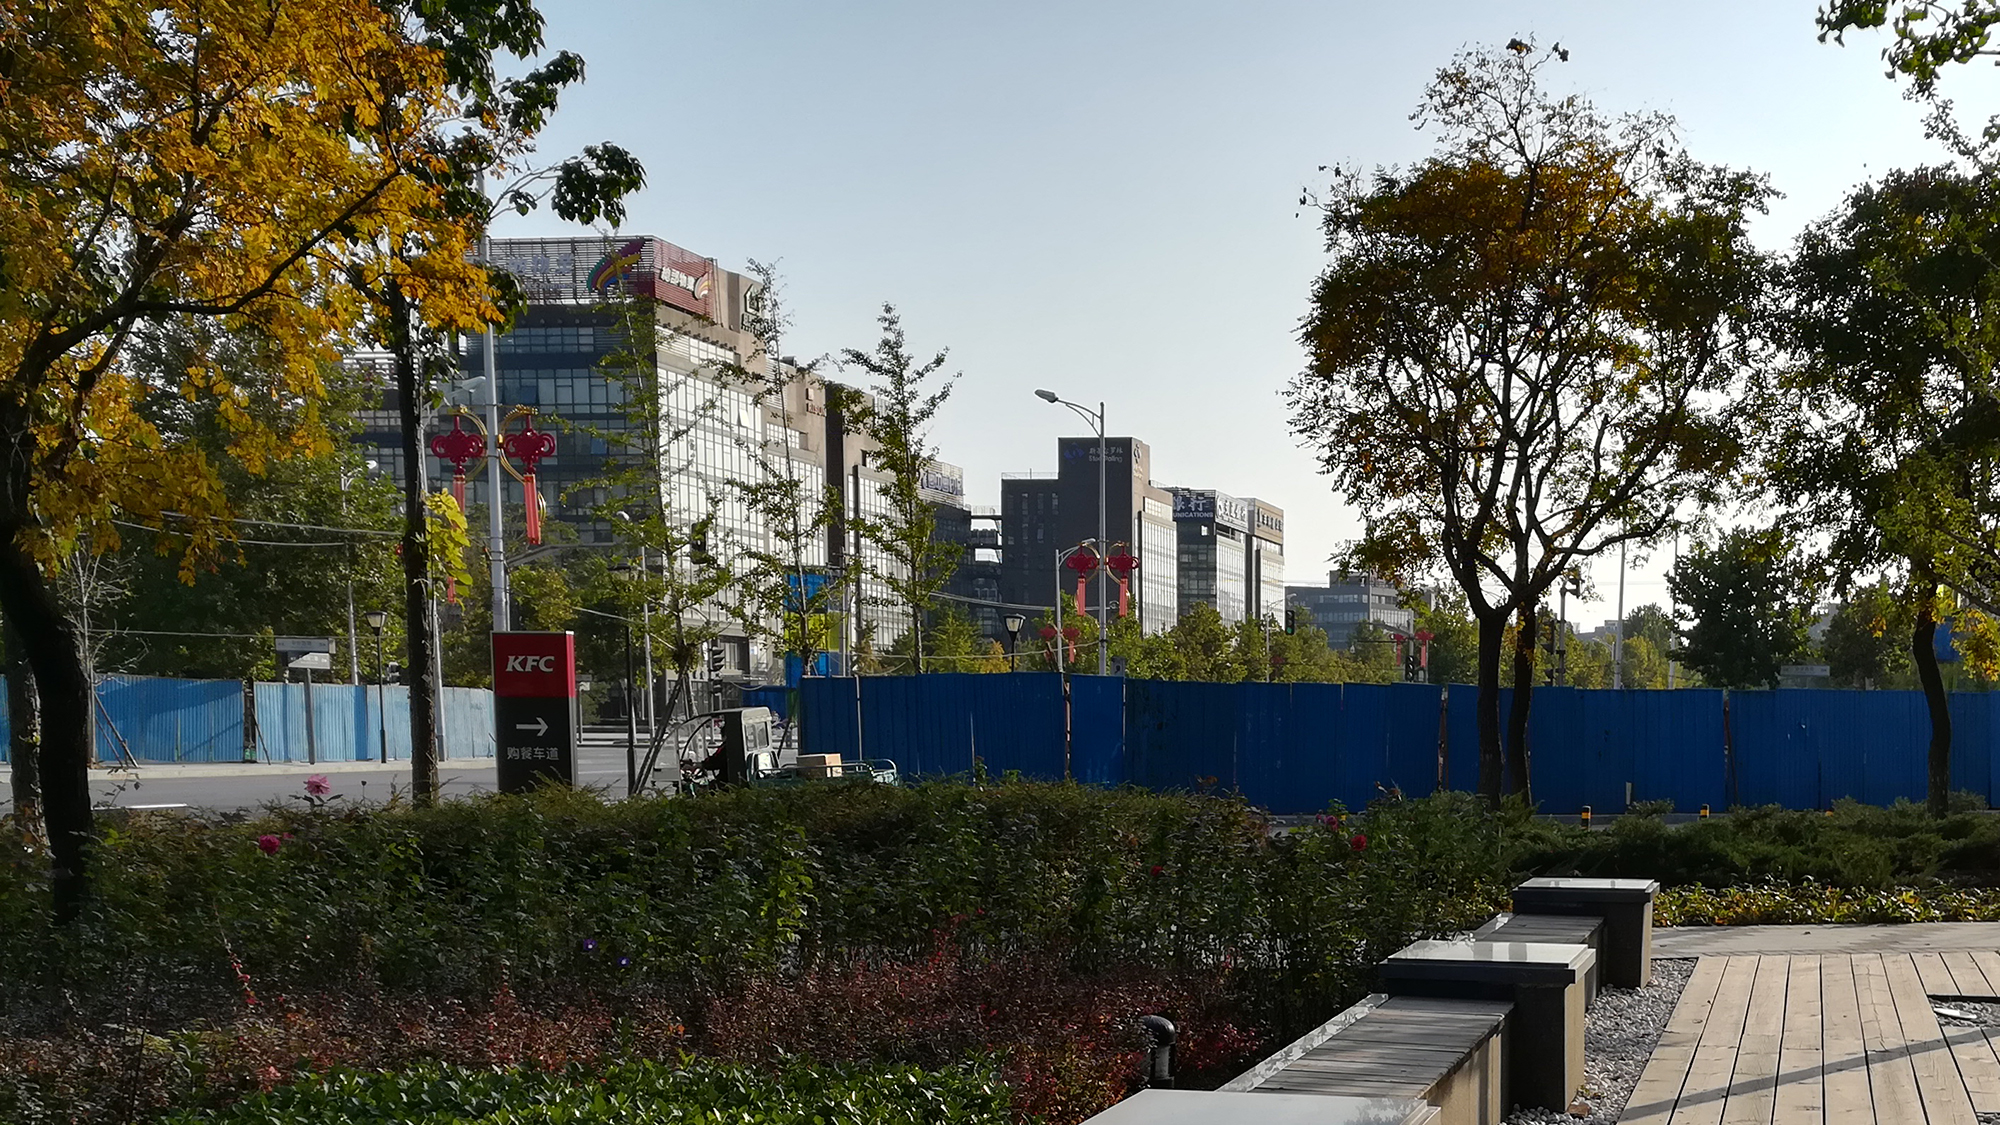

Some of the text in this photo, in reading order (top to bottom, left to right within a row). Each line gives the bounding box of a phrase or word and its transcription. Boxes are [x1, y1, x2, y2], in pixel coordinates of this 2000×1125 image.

[505, 655, 555, 672] KFC
[507, 746, 559, 760] 购餐车道
